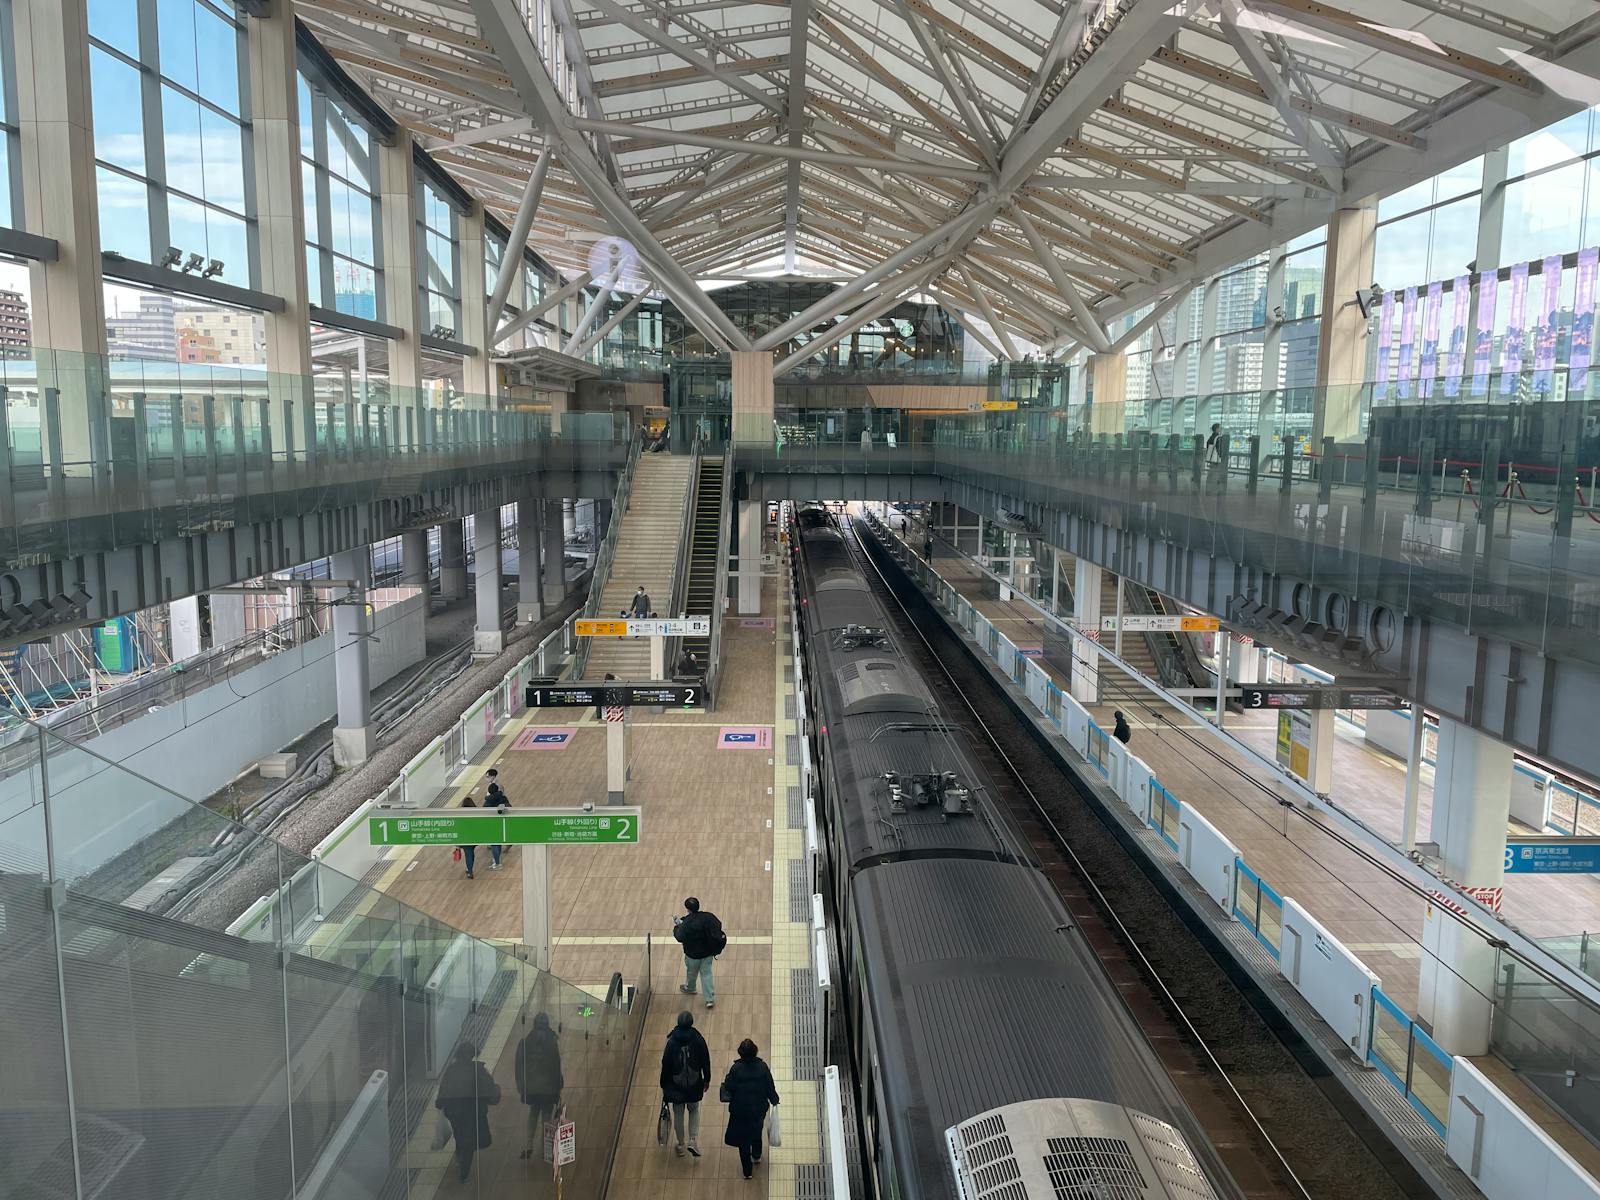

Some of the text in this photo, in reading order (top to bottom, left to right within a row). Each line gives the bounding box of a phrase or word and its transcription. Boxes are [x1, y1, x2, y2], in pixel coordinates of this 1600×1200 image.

[533, 690, 541, 706] 1
[684, 688, 695, 704] 2
[1251, 692, 1262, 707] 3
[378, 821, 388, 842] 1
[617, 819, 630, 839] 2
